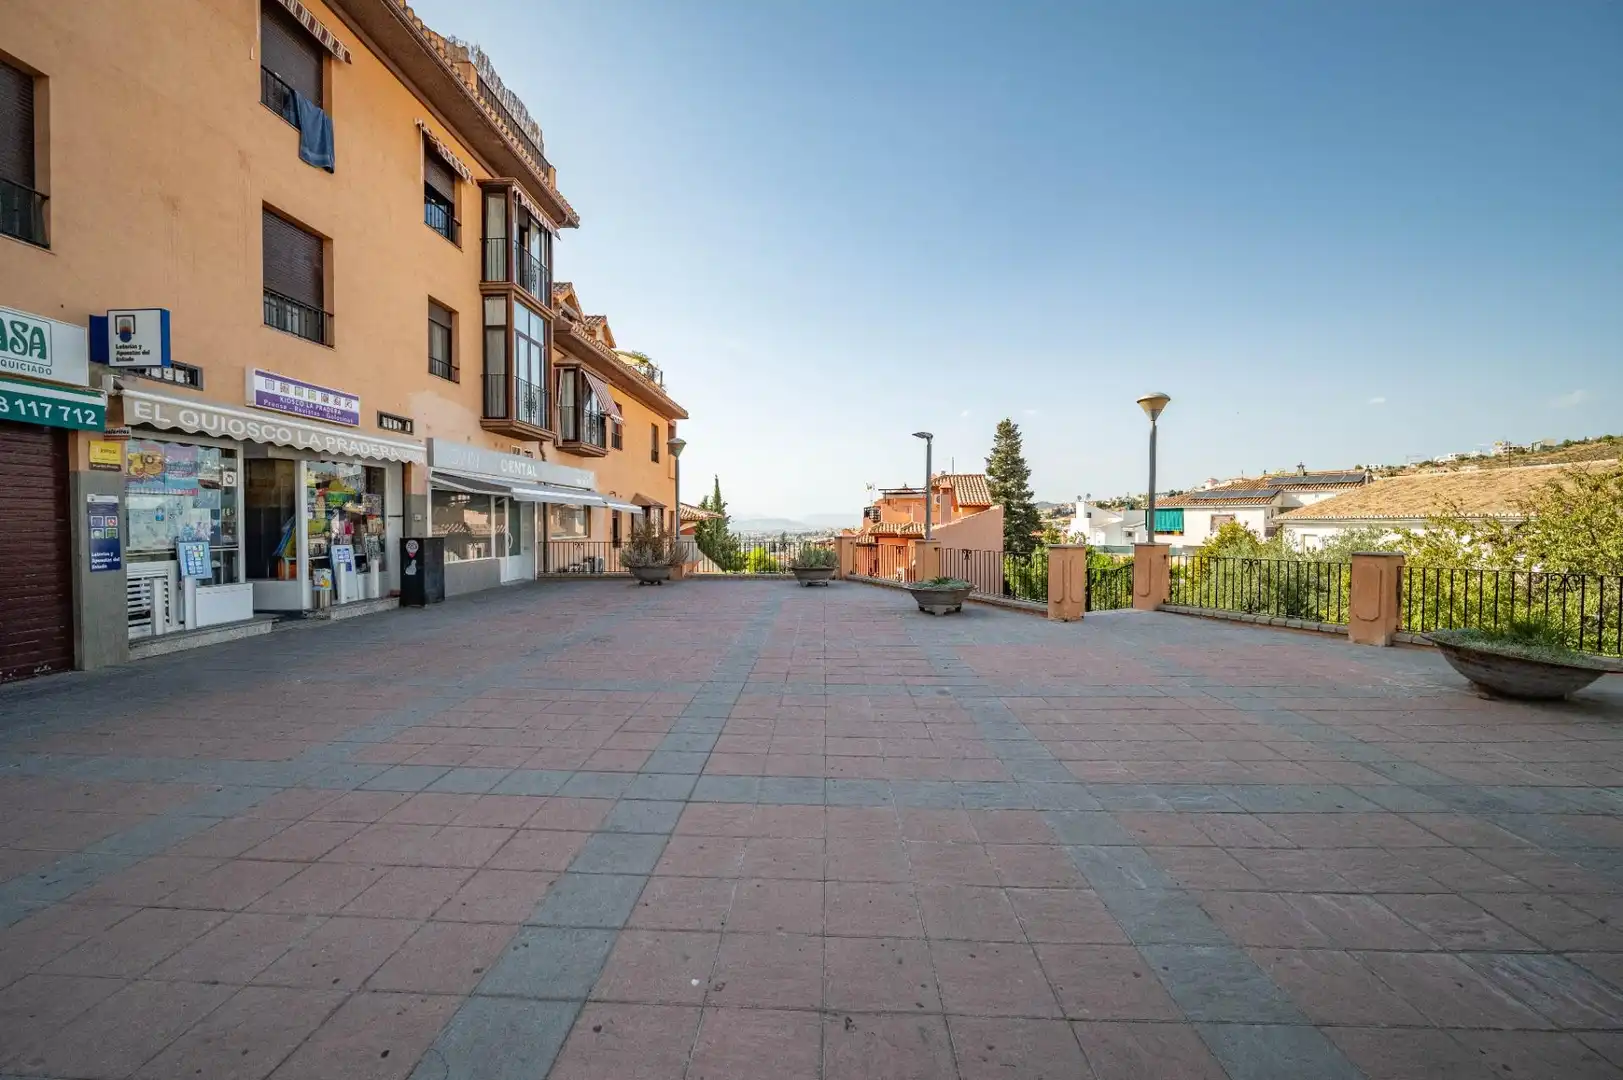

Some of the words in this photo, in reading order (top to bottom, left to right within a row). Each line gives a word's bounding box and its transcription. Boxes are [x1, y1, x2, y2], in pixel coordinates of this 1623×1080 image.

[14, 398, 53, 419] 117
[58, 405, 98, 425] 712
[263, 398, 288, 410] Prensa
[294, 404, 321, 417] Revistas
[279, 396, 305, 407] KIOSCO
[306, 402, 313, 410] LA
[315, 404, 342, 416] PRADERA
[134, 401, 171, 423] EL
[179, 409, 292, 442] QUIOSCO
[298, 430, 321, 446] LA
[326, 437, 400, 458] PRADERA
[500, 458, 538, 478] DENTAL
